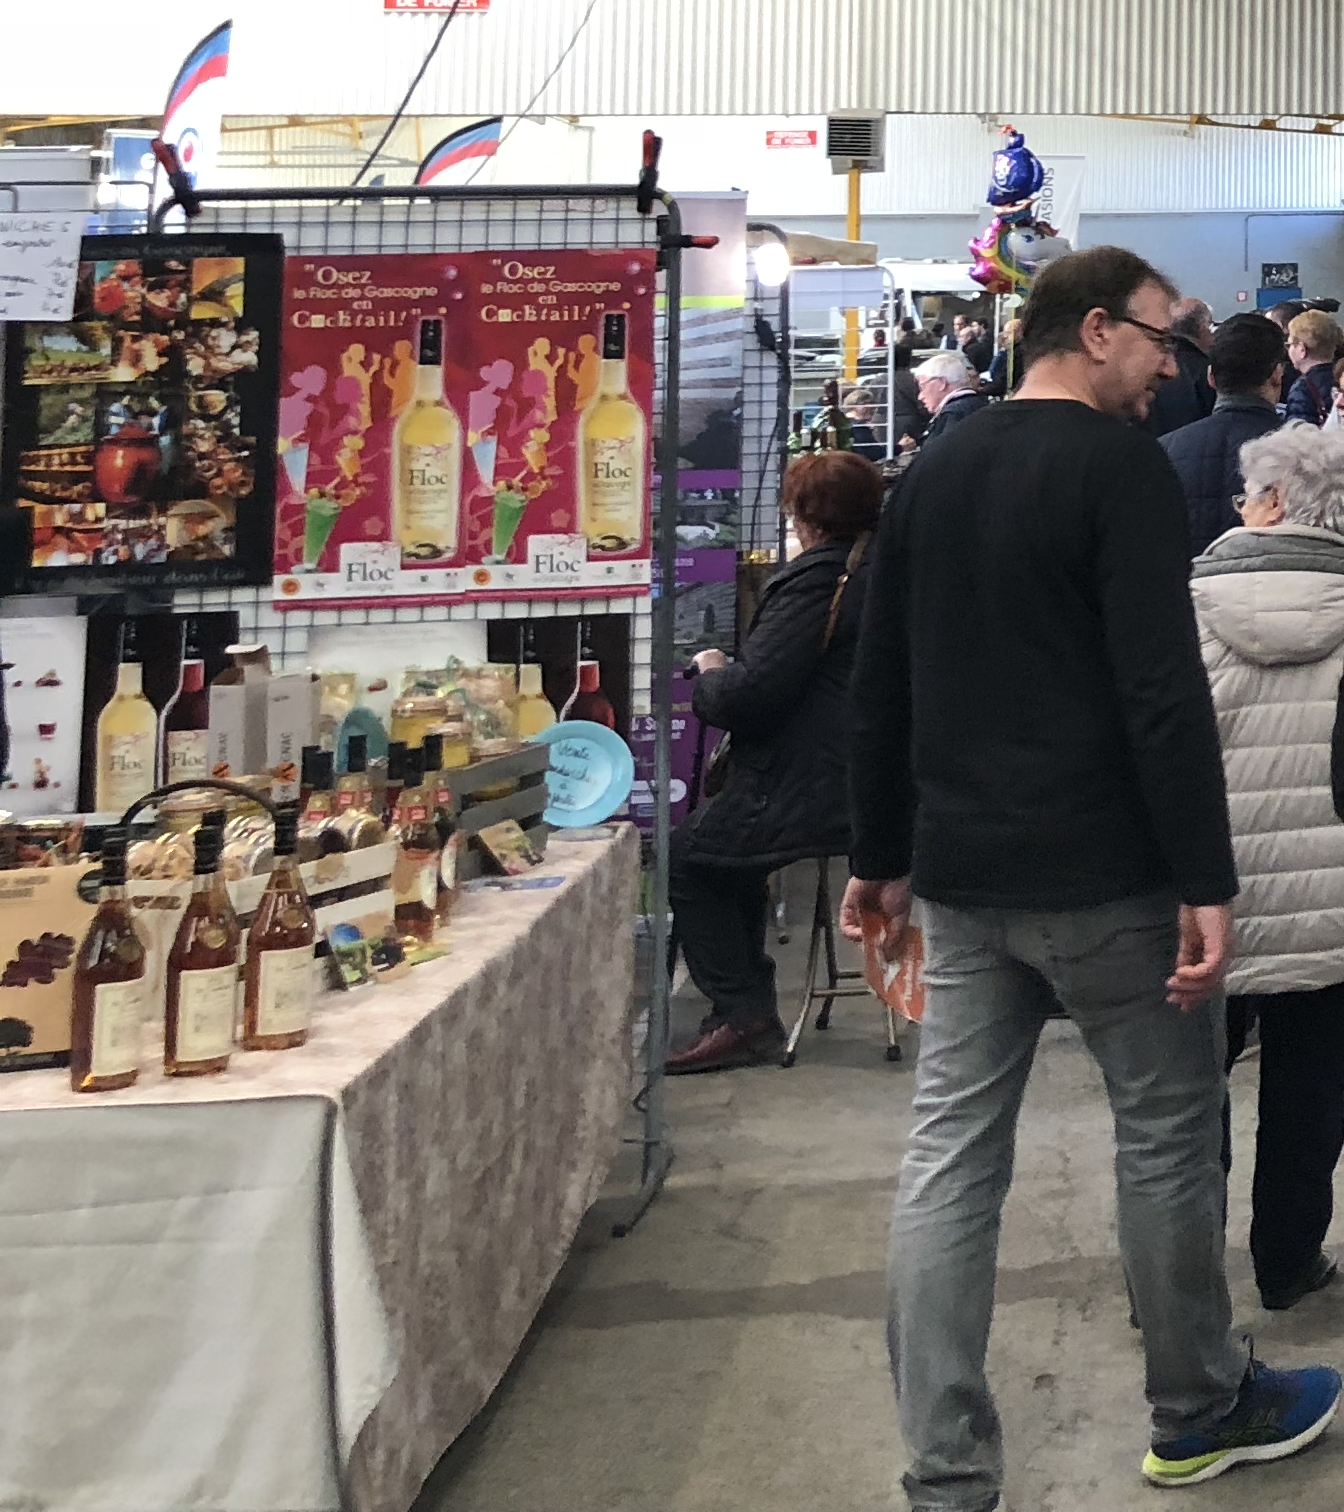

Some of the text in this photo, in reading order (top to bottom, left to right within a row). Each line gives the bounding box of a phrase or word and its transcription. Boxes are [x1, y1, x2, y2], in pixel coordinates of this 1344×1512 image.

[1041, 167, 1055, 222] ASIONS
[409, 468, 449, 487] Floc
[593, 461, 633, 480] Floc
[346, 561, 395, 583] Floc
[533, 553, 582, 574] Floc
